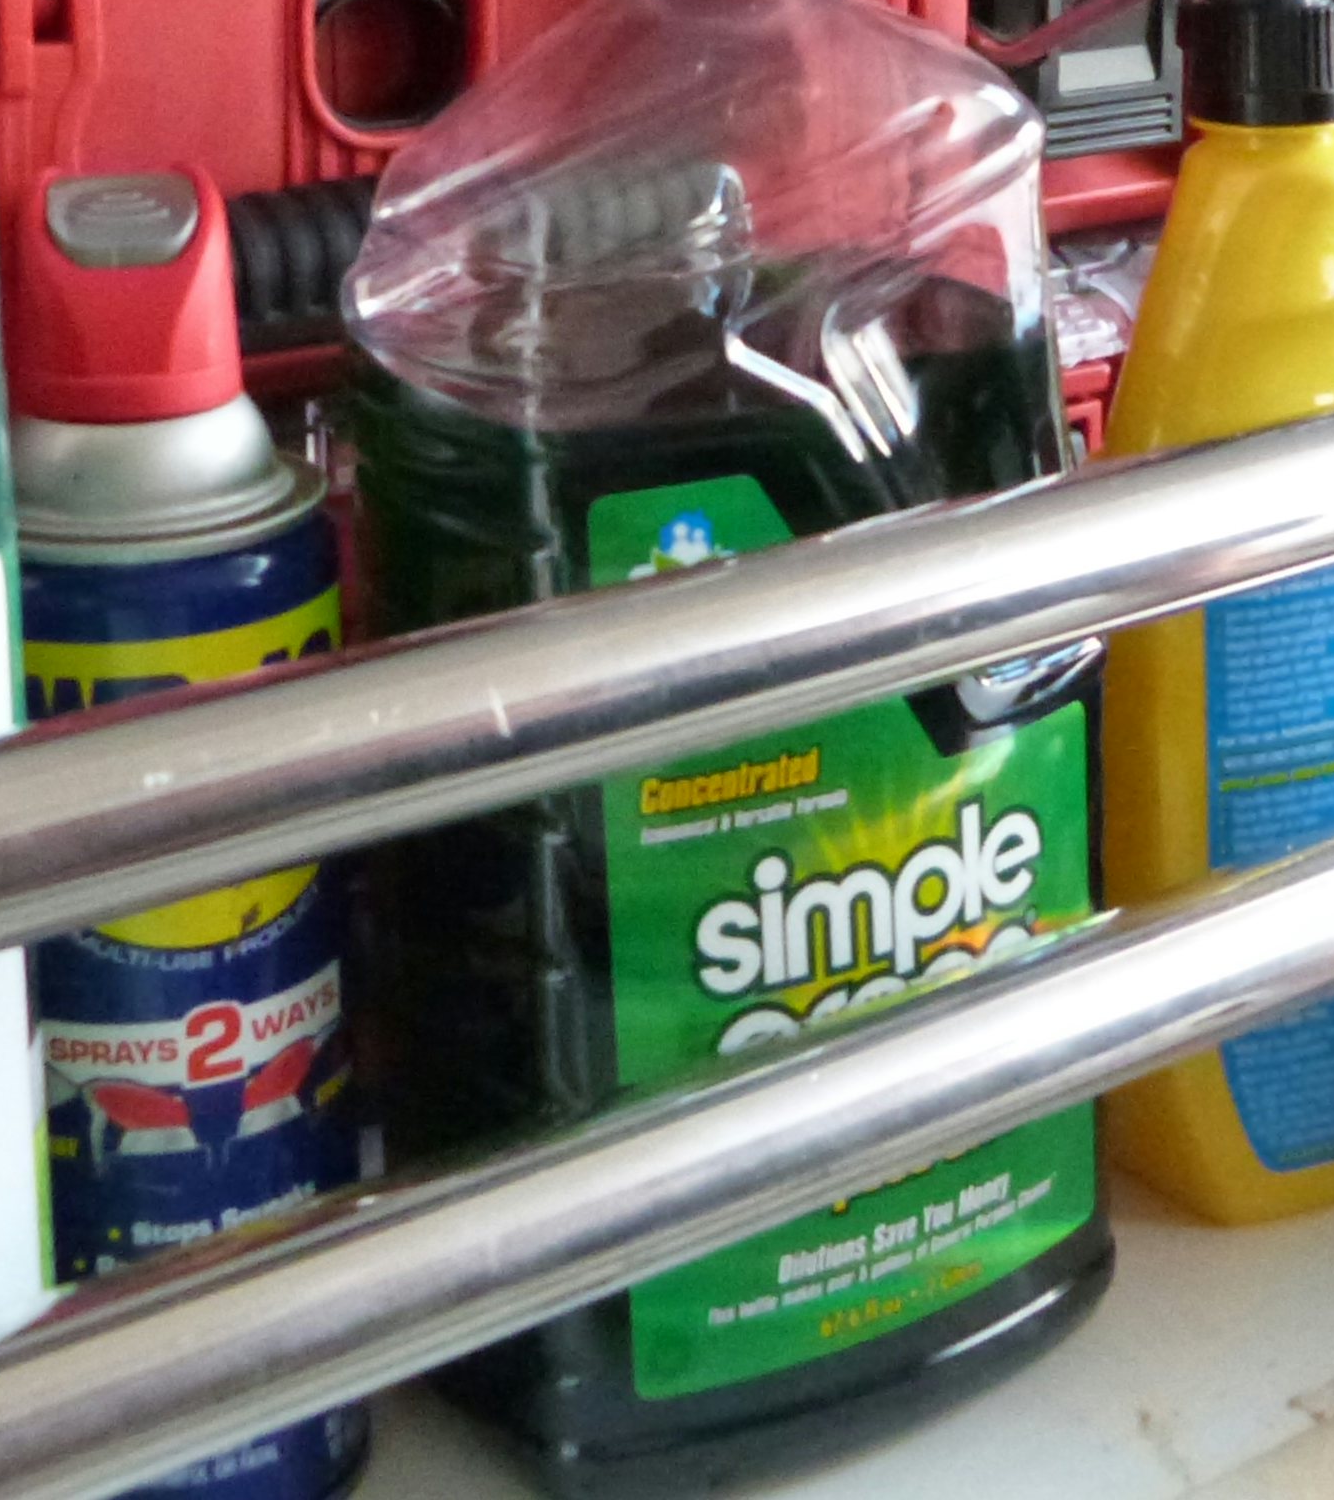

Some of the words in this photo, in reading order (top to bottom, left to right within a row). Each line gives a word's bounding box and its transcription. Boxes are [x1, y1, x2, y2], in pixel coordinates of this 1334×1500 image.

[641, 746, 820, 814] Concentrated
[695, 801, 1043, 995] simple
[48, 1036, 179, 1065] SPRAYS
[185, 1004, 245, 1083] 2
[252, 982, 338, 1040] WAYS
[872, 1214, 918, 1254] Save
[923, 1201, 954, 1233] You
